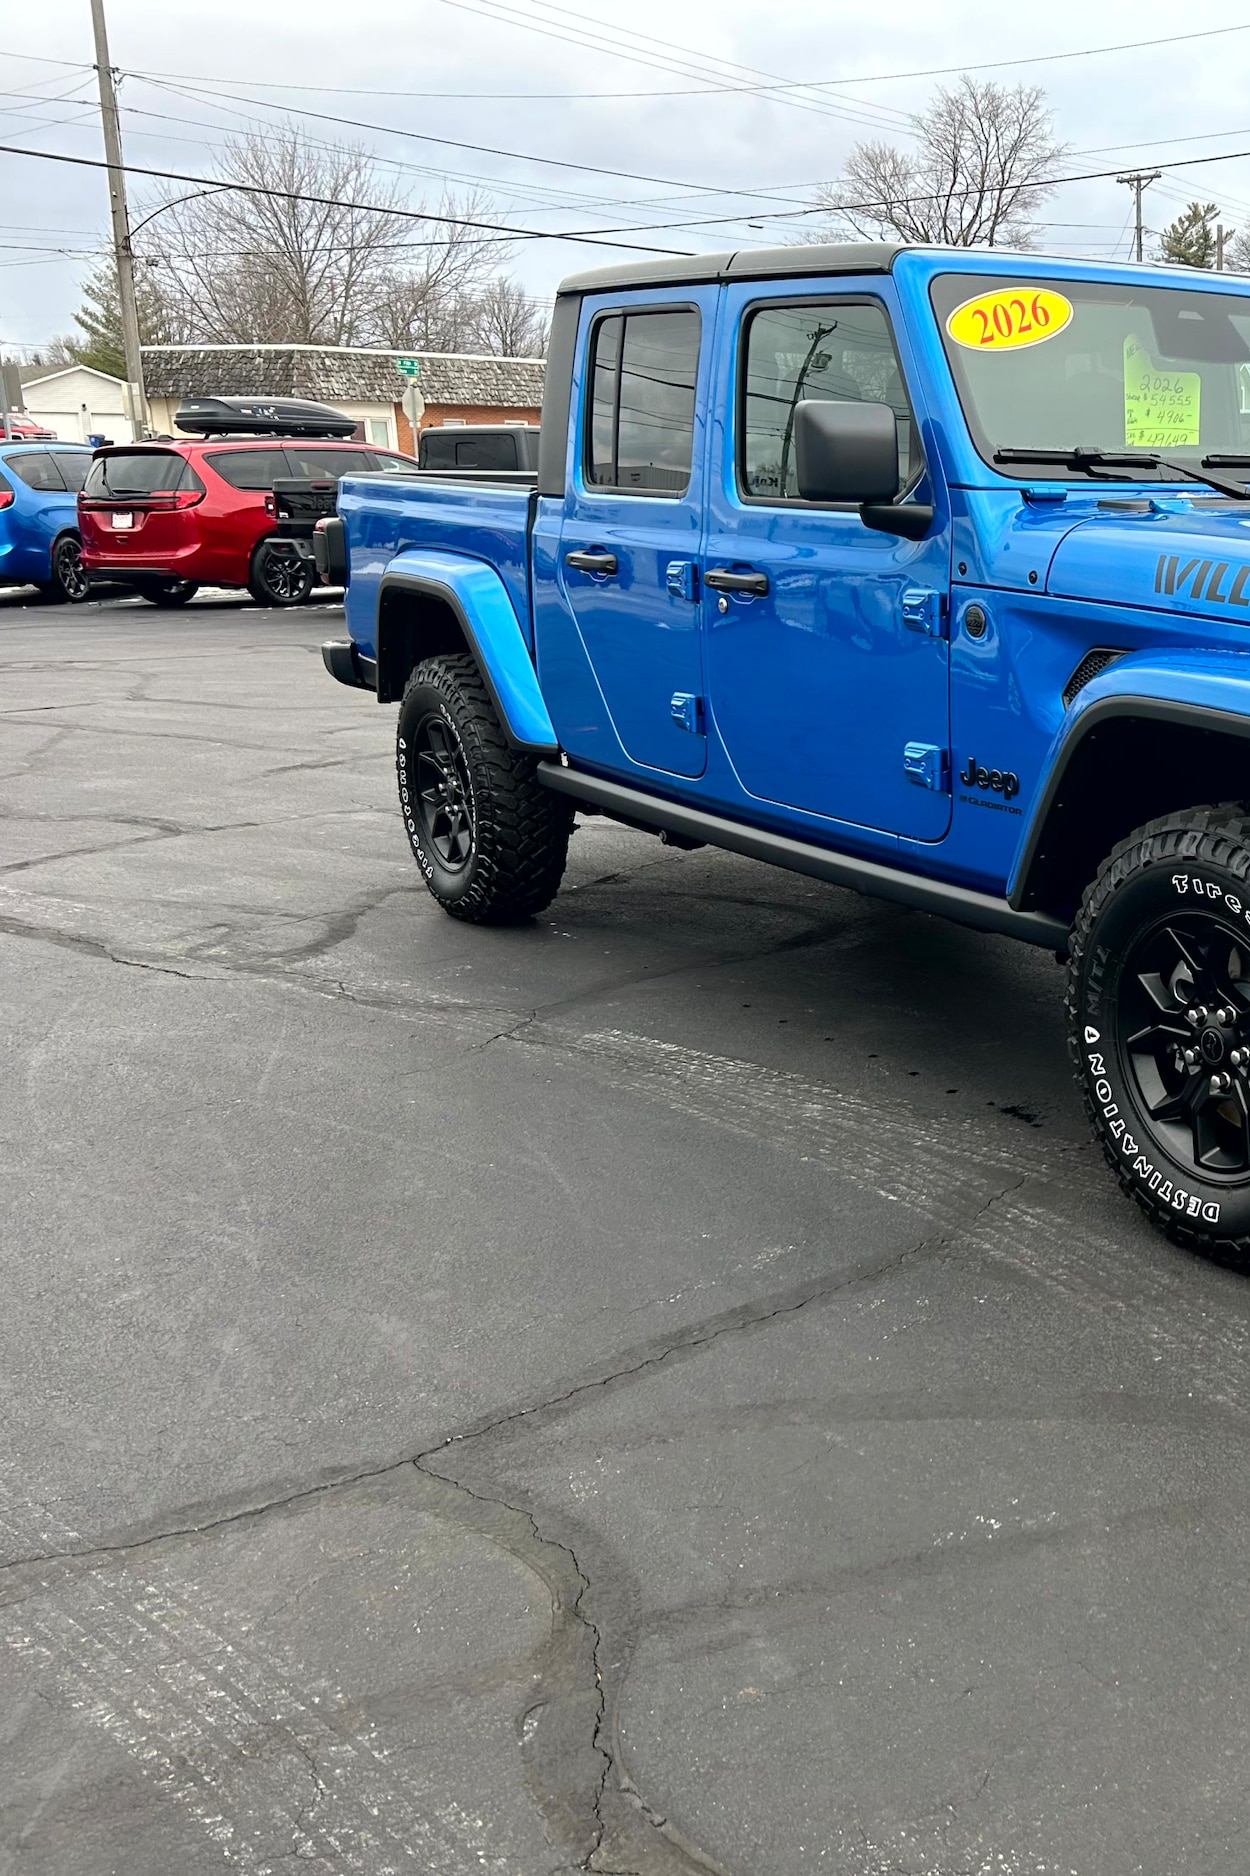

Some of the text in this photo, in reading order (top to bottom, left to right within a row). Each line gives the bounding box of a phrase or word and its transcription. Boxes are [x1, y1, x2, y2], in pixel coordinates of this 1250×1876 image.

[972, 293, 1050, 344] 2026
[1140, 374, 1184, 394] 2026
[960, 756, 1020, 801] Jeep
[968, 796, 1023, 816] GLADIATOR
[1088, 1053, 1221, 1223] DESTINATION
